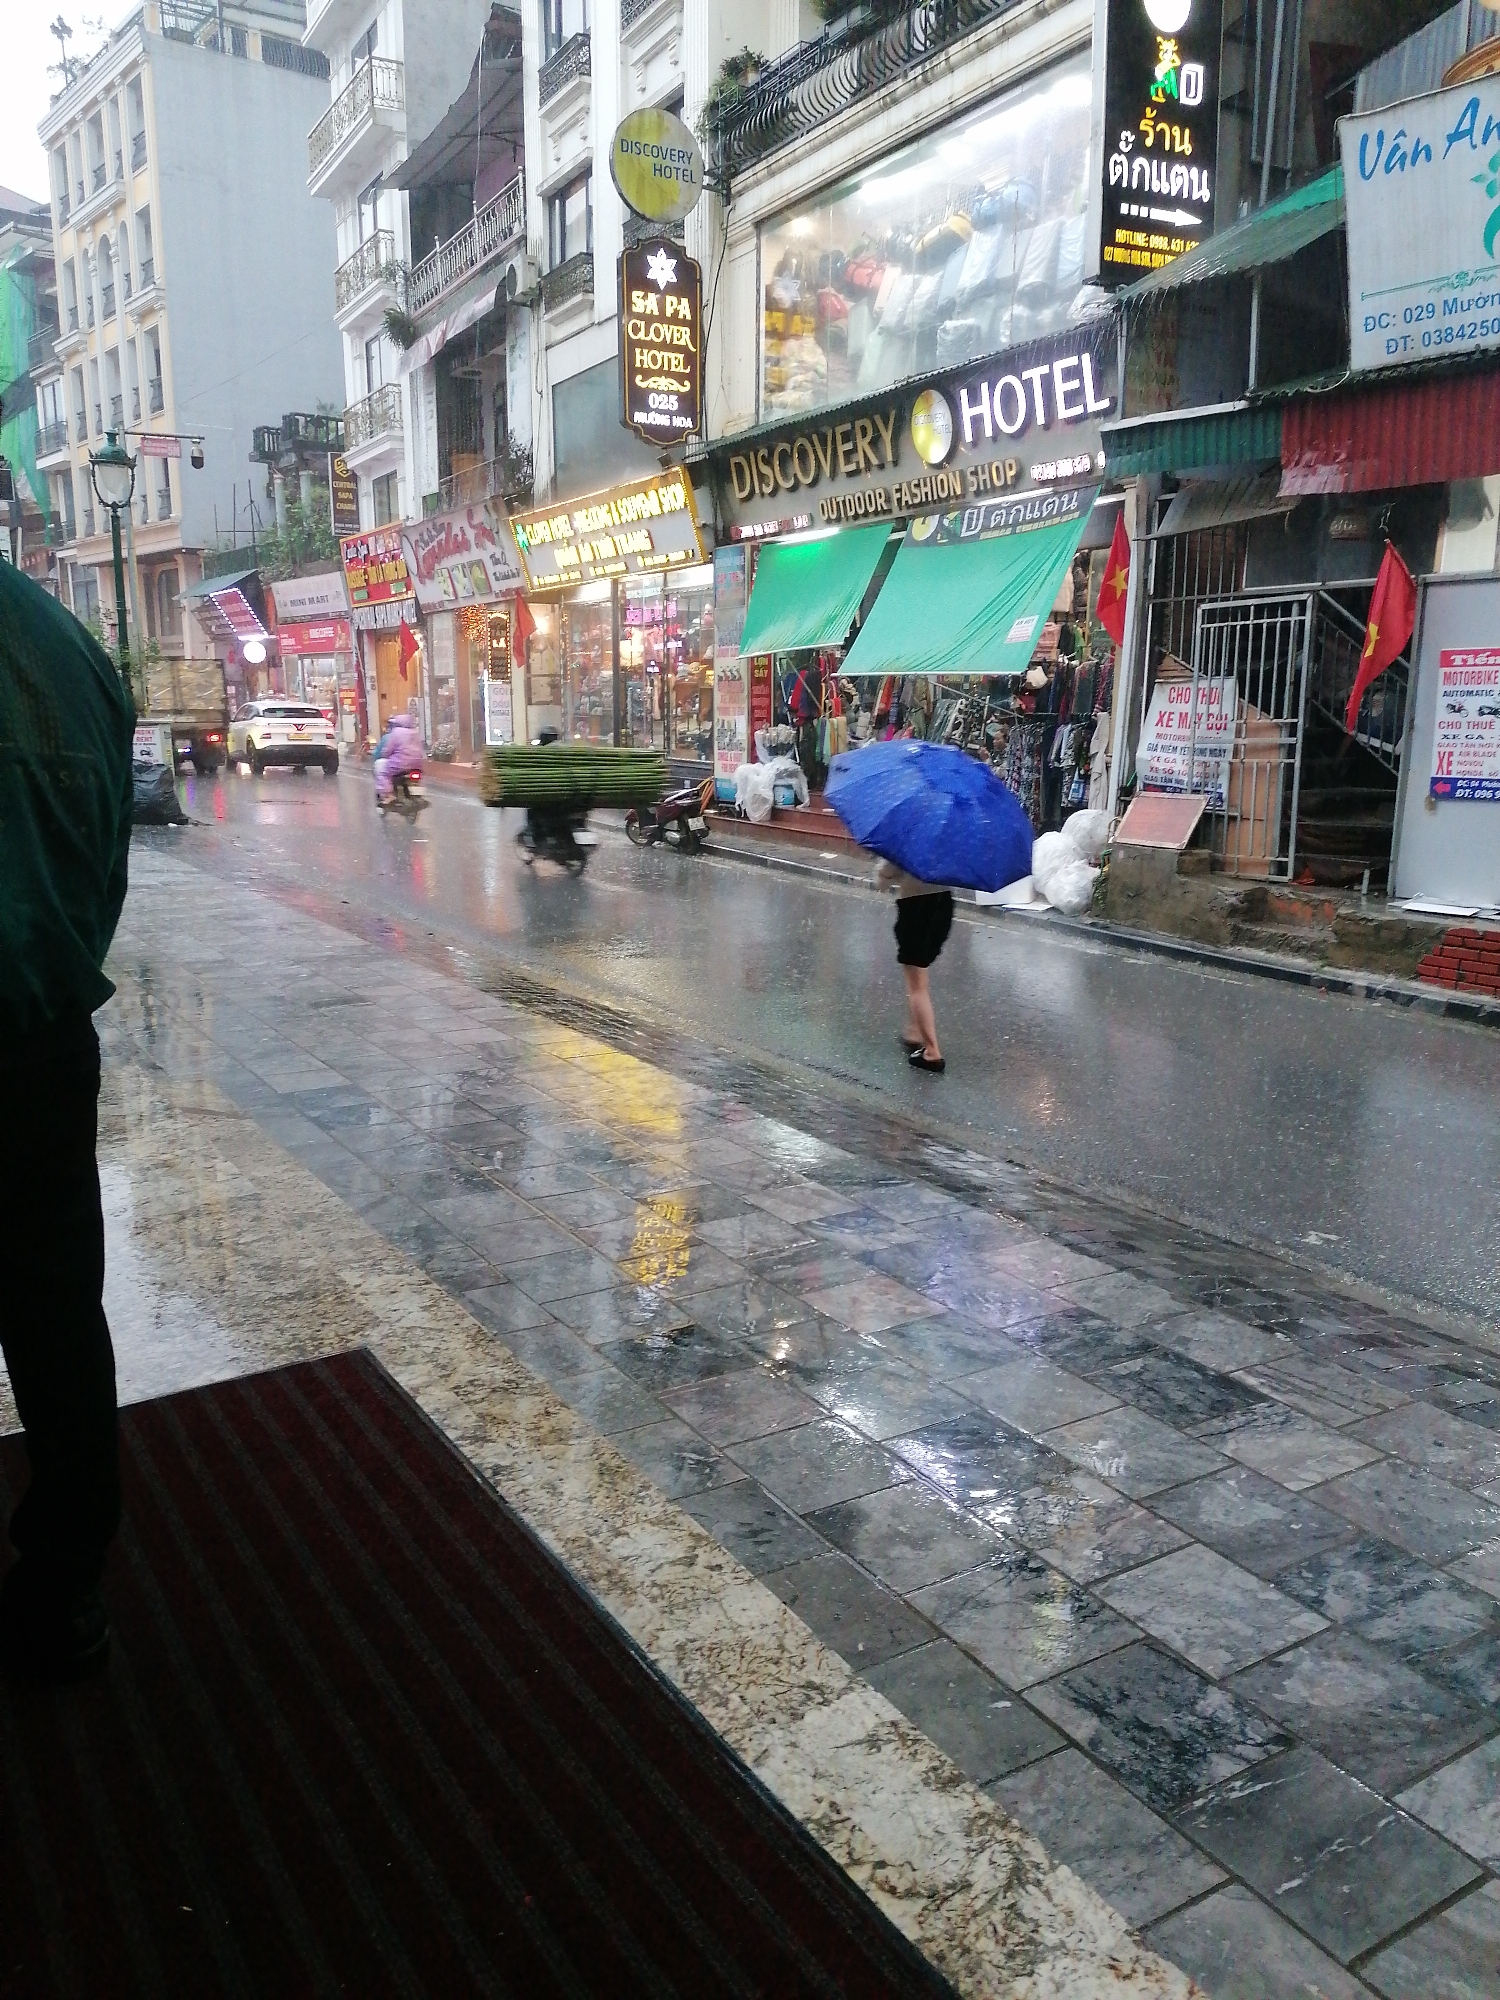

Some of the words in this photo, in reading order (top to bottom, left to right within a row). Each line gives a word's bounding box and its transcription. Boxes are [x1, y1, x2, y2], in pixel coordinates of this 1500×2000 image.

[1140, 107, 1192, 156] ร้าน
[620, 138, 693, 165] DISCOVERY
[1359, 128, 1432, 181] Vân
[653, 163, 697, 184] HOTEL
[1109, 130, 1210, 203] ตั๊กแตน
[631, 290, 659, 315] SA
[665, 294, 692, 320] PA
[1364, 312, 1396, 332] ĐC:
[1403, 302, 1436, 324] 029
[627, 319, 697, 352] CLOVER
[1385, 334, 1415, 355] ĐT:
[634, 347, 691, 373] HOTEL
[648, 392, 679, 411] 025
[729, 409, 896, 499] DISCOVERY
[959, 352, 1110, 443] HOTEL
[818, 487, 887, 521] OUTDOOR
[892, 470, 962, 507] FASHION
[966, 458, 1017, 492] SHOP
[290, 598, 307, 608] MINI
[308, 595, 330, 605] MART
[1442, 669, 1499, 686] MOTORBIKE
[1168, 686, 1192, 704] CHO
[1442, 689, 1495, 698] AUTOMATIC
[1155, 711, 1175, 728] XE
[1438, 720, 1462, 730] CHO
[1466, 719, 1496, 730] THUÊ
[1435, 750, 1454, 776] XE
[1472, 750, 1497, 758] BLADE
[1474, 789, 1493, 799] 096
